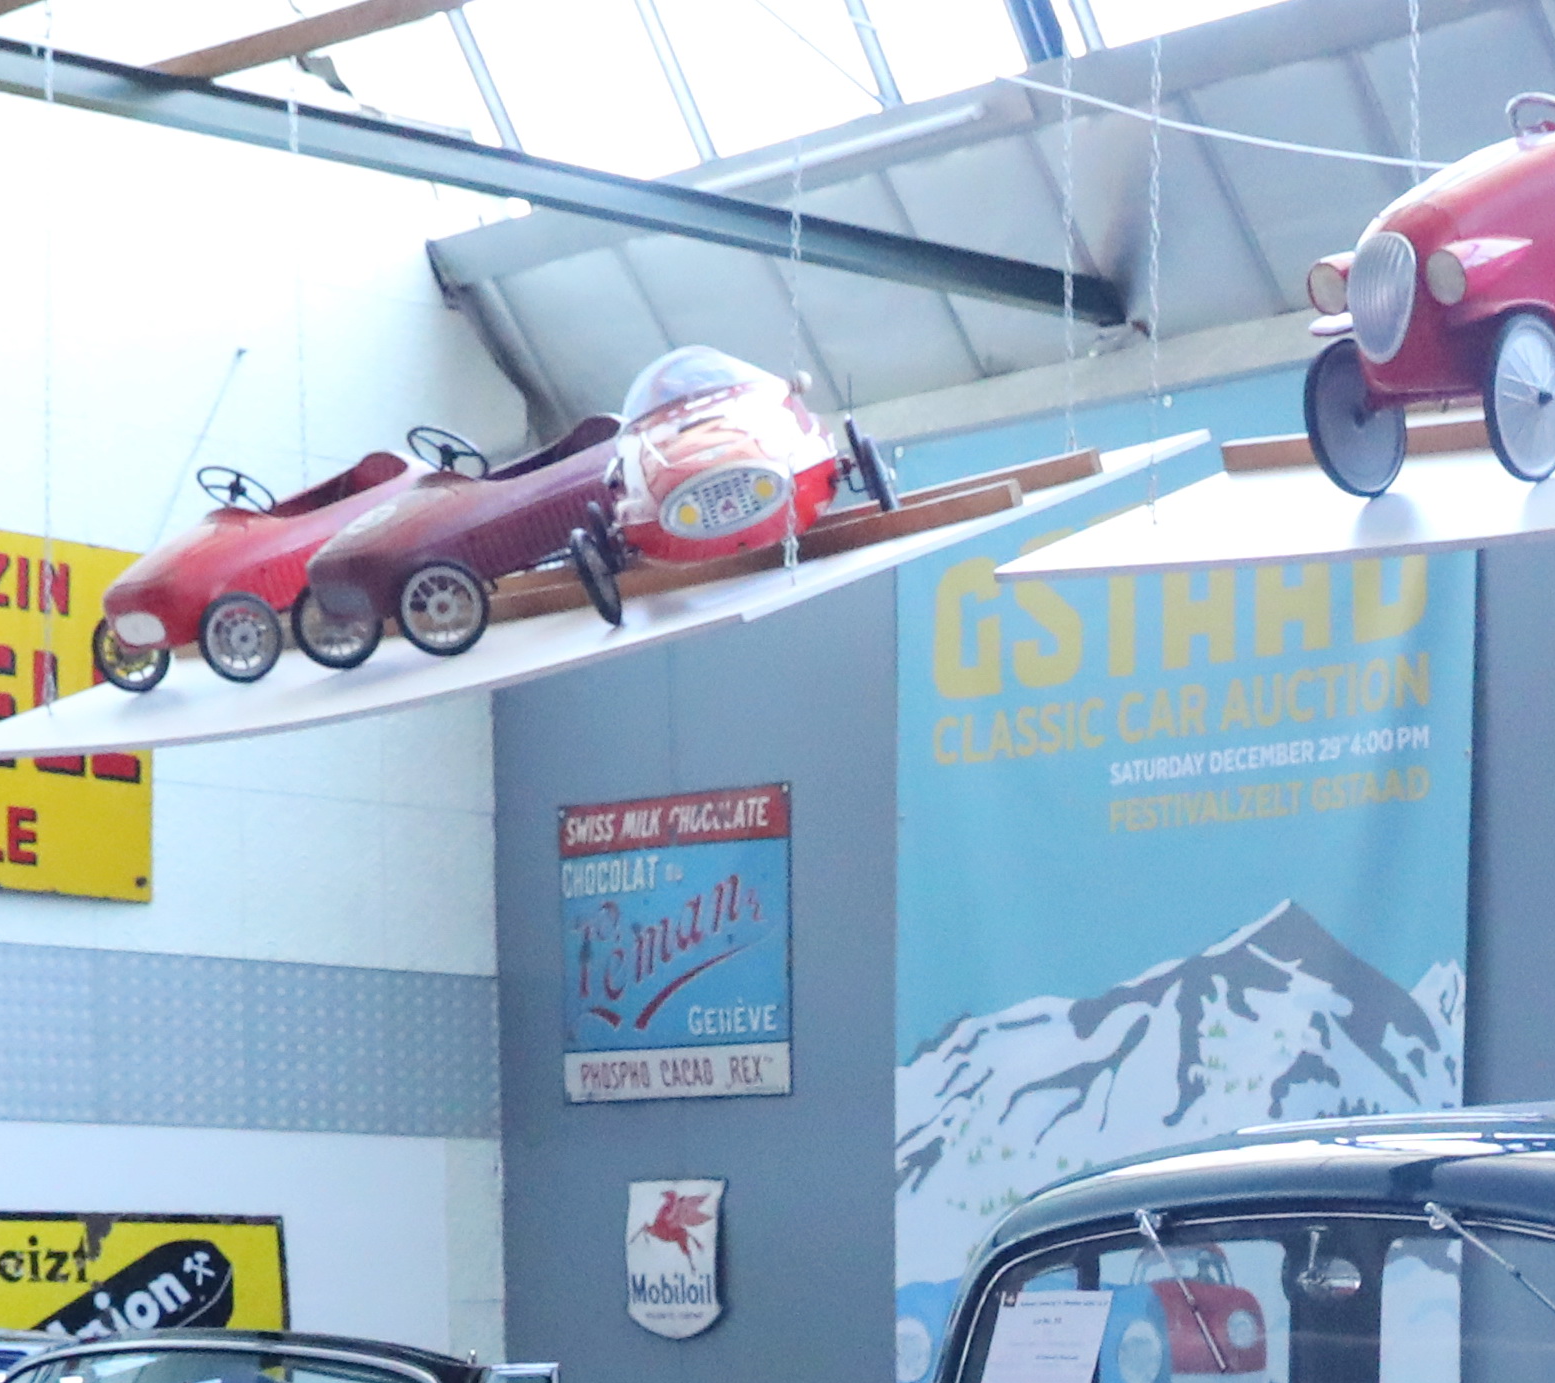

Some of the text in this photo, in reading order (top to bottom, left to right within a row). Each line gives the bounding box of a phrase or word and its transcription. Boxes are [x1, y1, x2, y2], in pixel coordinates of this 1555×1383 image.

[933, 653, 1431, 766] CLASSIC CAR AUCTION
[1109, 752, 1205, 786] SATURDAY
[1210, 740, 1314, 774] DECEMBER
[1396, 725, 1430, 750] PM
[1109, 766, 1431, 833] FESTIVALZELT GSTAAD
[565, 813, 616, 847] SWISS
[620, 807, 663, 838] MILK
[561, 855, 660, 899] CHOCOLAT
[580, 1060, 651, 1091] PHOSPHO
[660, 1057, 714, 1088] CACAO
[46, 1272, 193, 1337] ion
[630, 1272, 713, 1305] Mobiloil
